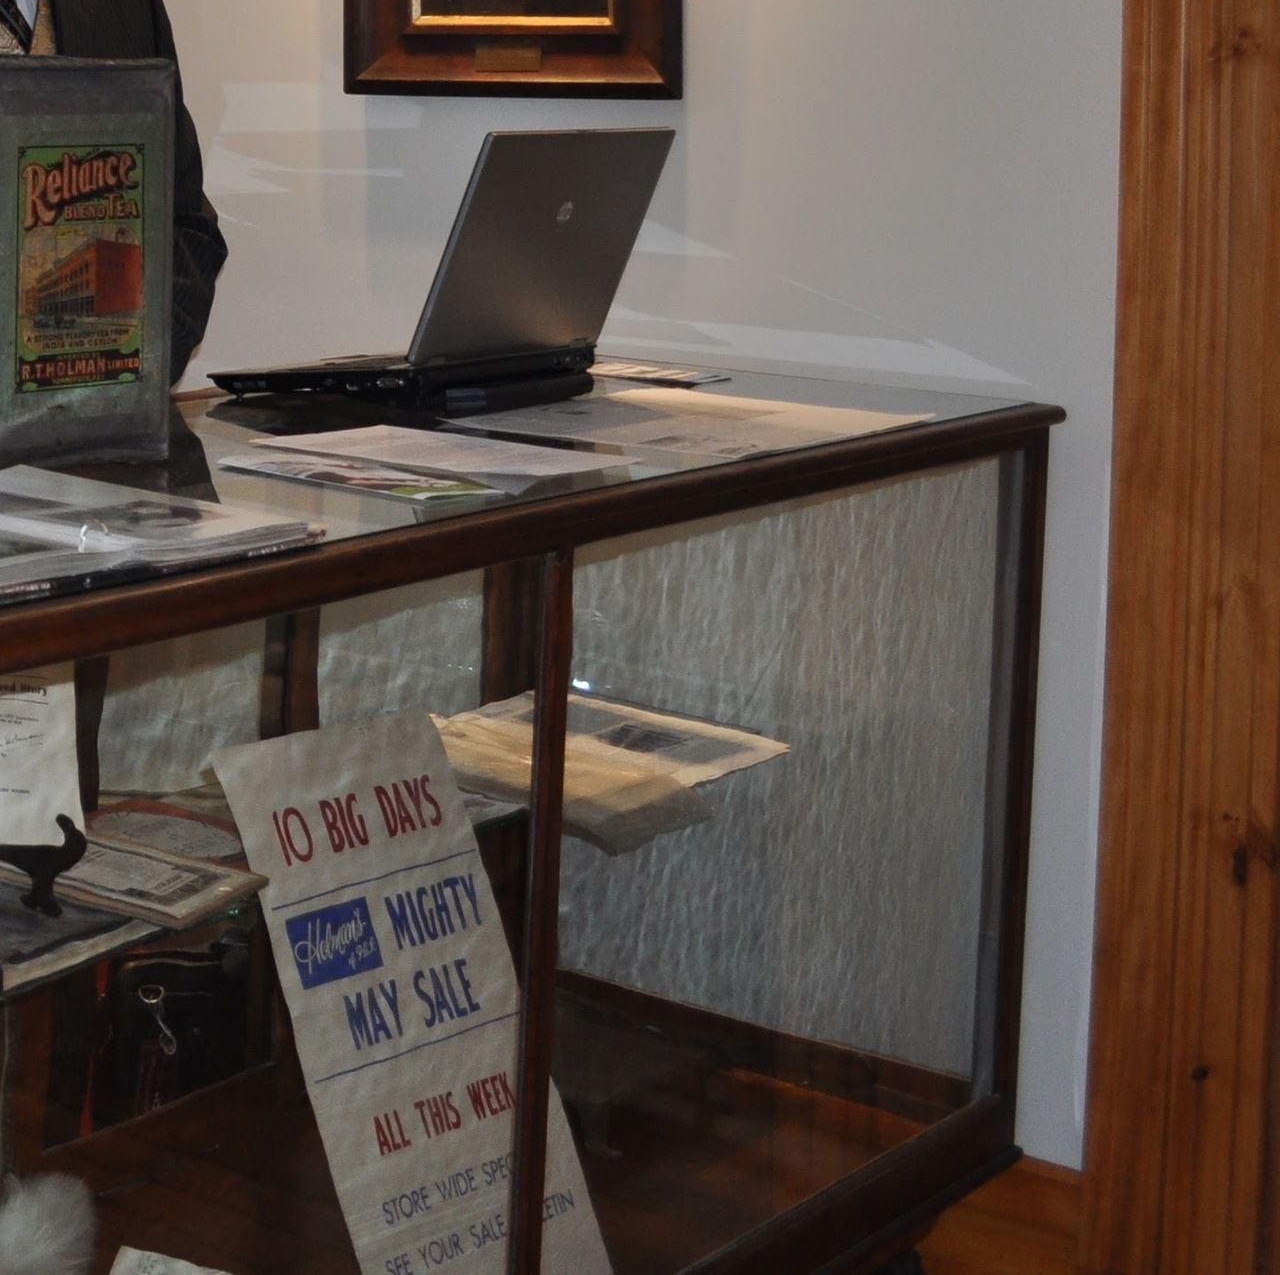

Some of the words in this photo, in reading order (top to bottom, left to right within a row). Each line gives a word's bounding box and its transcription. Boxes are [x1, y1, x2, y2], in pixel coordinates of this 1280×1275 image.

[21, 150, 140, 231] Reliance
[64, 203, 106, 223] BLEND
[104, 193, 141, 221] TEA
[20, 682, 48, 697] Story
[272, 806, 314, 867] 10
[318, 793, 370, 853] BIG
[374, 775, 442, 838] DAYS
[384, 874, 482, 950] MIGHTY
[344, 979, 404, 1050] MAY
[413, 958, 481, 1028] SALE
[374, 1109, 412, 1156] ALL
[414, 1091, 462, 1149] THIS
[467, 1071, 516, 1131] WEEK
[382, 1186, 432, 1225] STORE
[435, 1168, 478, 1201] WIDE
[481, 1152, 514, 1185] SPEC
[416, 1233, 465, 1269] YOUR
[469, 1214, 510, 1249] SALE
